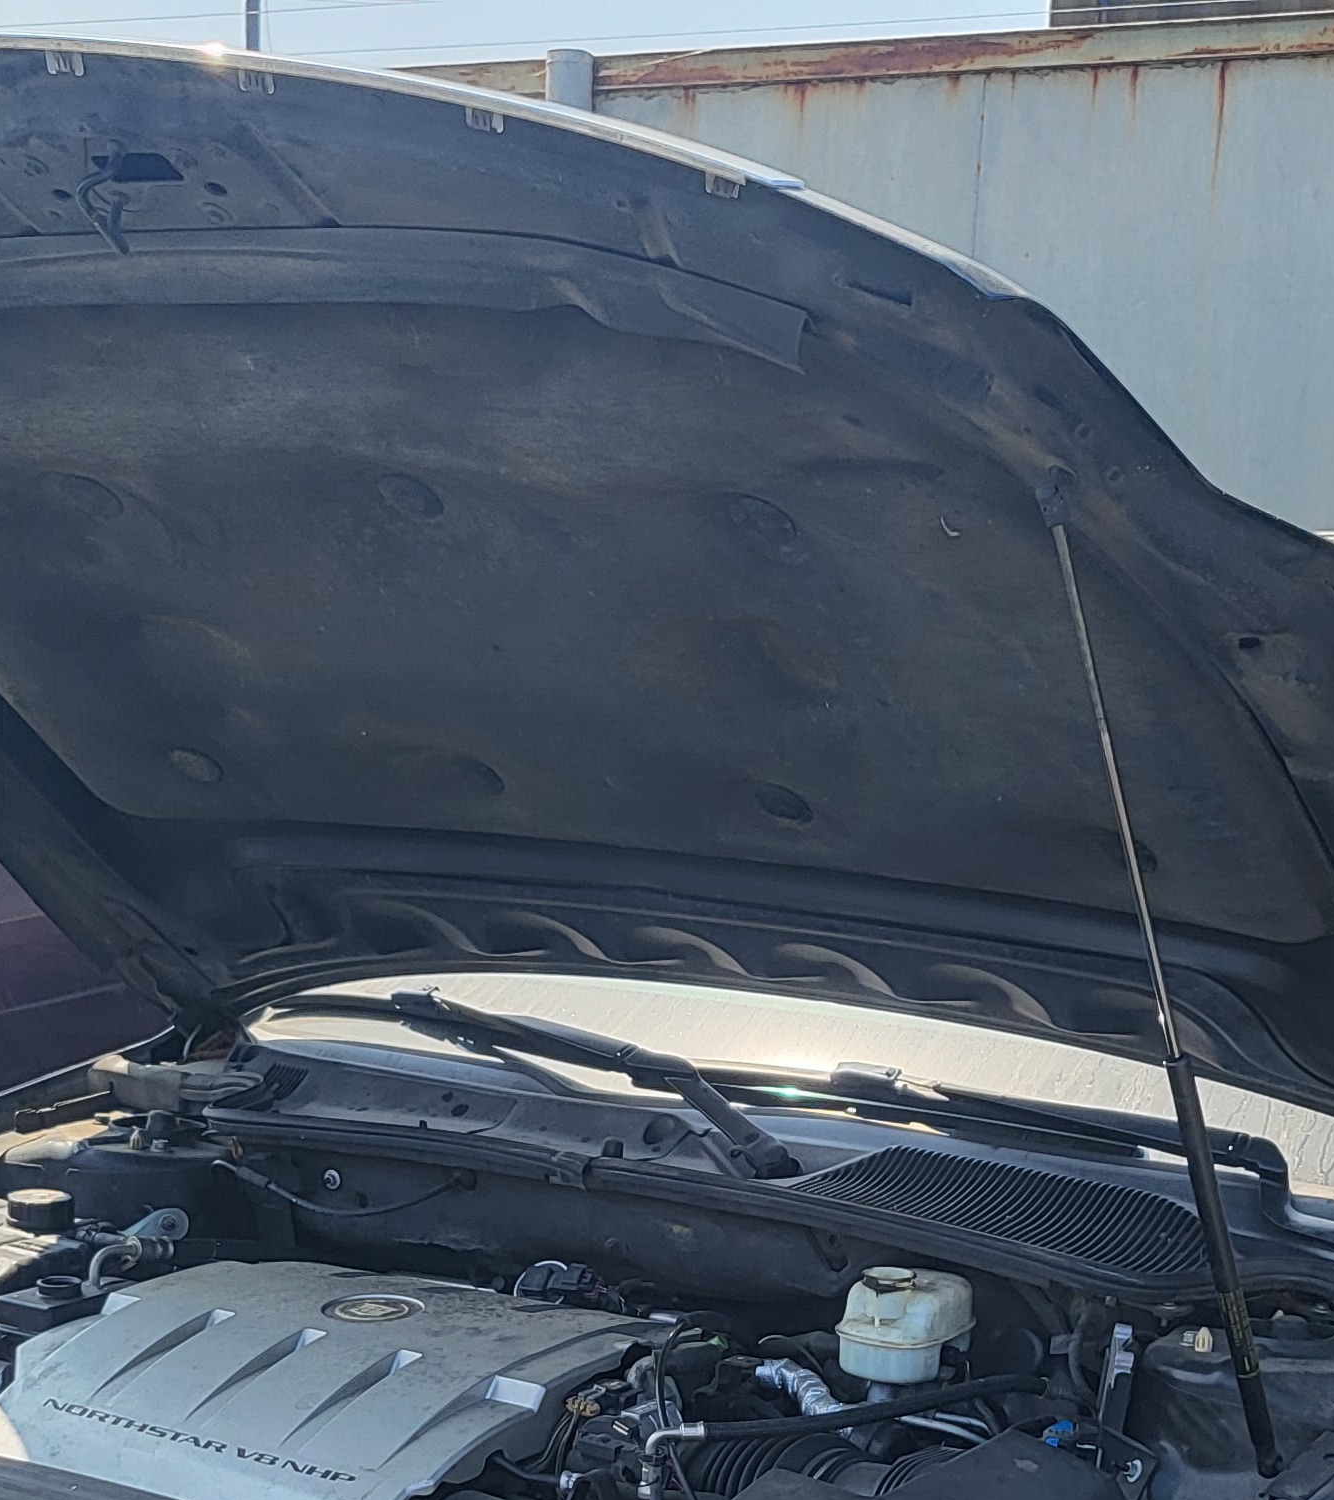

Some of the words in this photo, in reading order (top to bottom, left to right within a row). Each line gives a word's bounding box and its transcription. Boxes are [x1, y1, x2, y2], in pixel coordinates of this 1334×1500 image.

[43, 1397, 228, 1453] NORTHSTAR
[236, 1447, 280, 1466] V8
[280, 1459, 357, 1483] NHP
